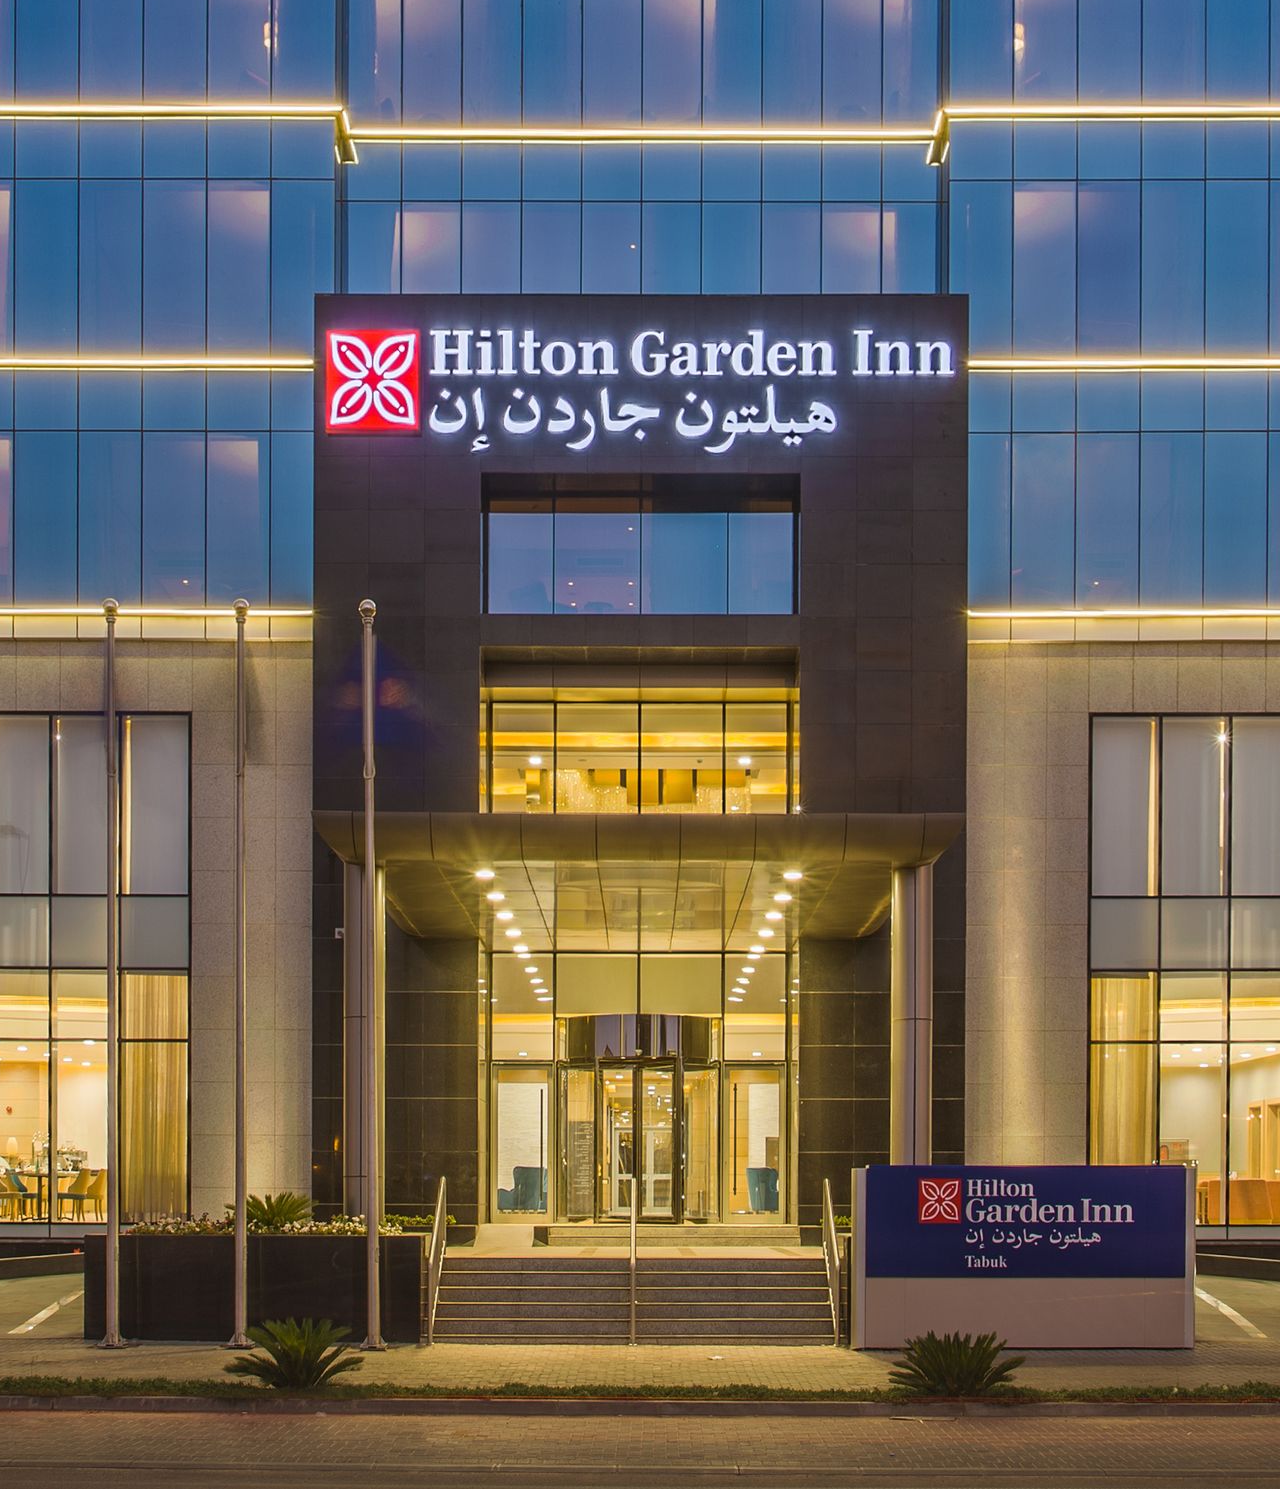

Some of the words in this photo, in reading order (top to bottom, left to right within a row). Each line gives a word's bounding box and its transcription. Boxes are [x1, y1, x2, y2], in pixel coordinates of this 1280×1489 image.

[428, 329, 620, 377] Hilton
[628, 329, 838, 377] Garden
[850, 329, 956, 377] Inn
[428, 386, 491, 453] إن
[502, 386, 662, 452] جاردن
[675, 383, 838, 455] هيلتون
[967, 1179, 1034, 1197] Hilton
[965, 1198, 1076, 1223] Garden
[1081, 1198, 1134, 1223] Inn
[965, 1228, 985, 1249] إن
[992, 1228, 1042, 1249] جاردن
[1049, 1227, 1101, 1249] هيلتون
[964, 1255, 1007, 1268] Tabuk
